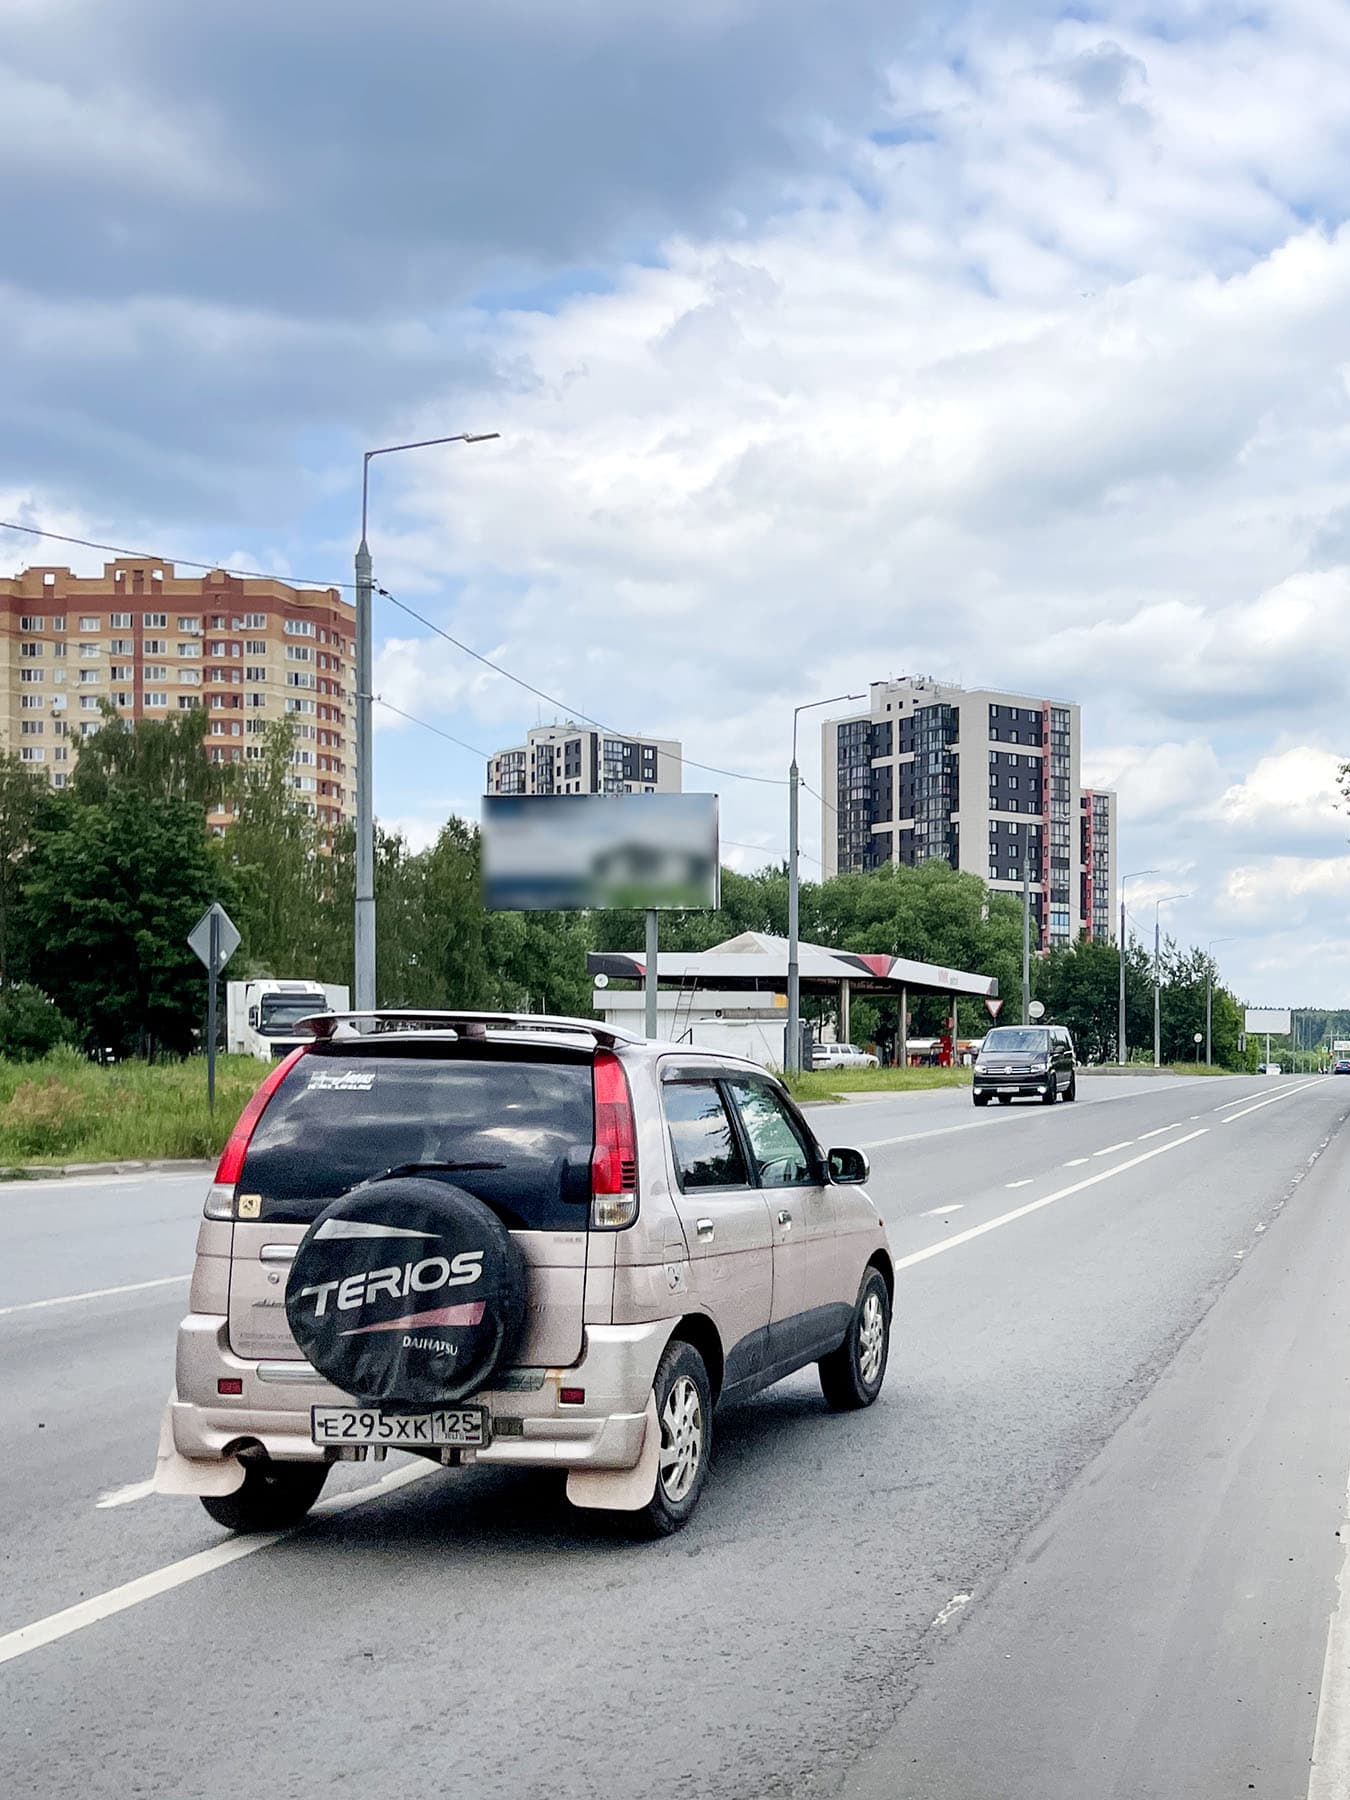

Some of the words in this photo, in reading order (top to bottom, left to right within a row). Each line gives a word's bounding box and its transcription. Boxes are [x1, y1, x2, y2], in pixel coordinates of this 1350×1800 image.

[301, 1250, 485, 1317] TERIOS
[402, 1335, 458, 1356] DAIHATSU
[435, 1412, 474, 1433] 125
